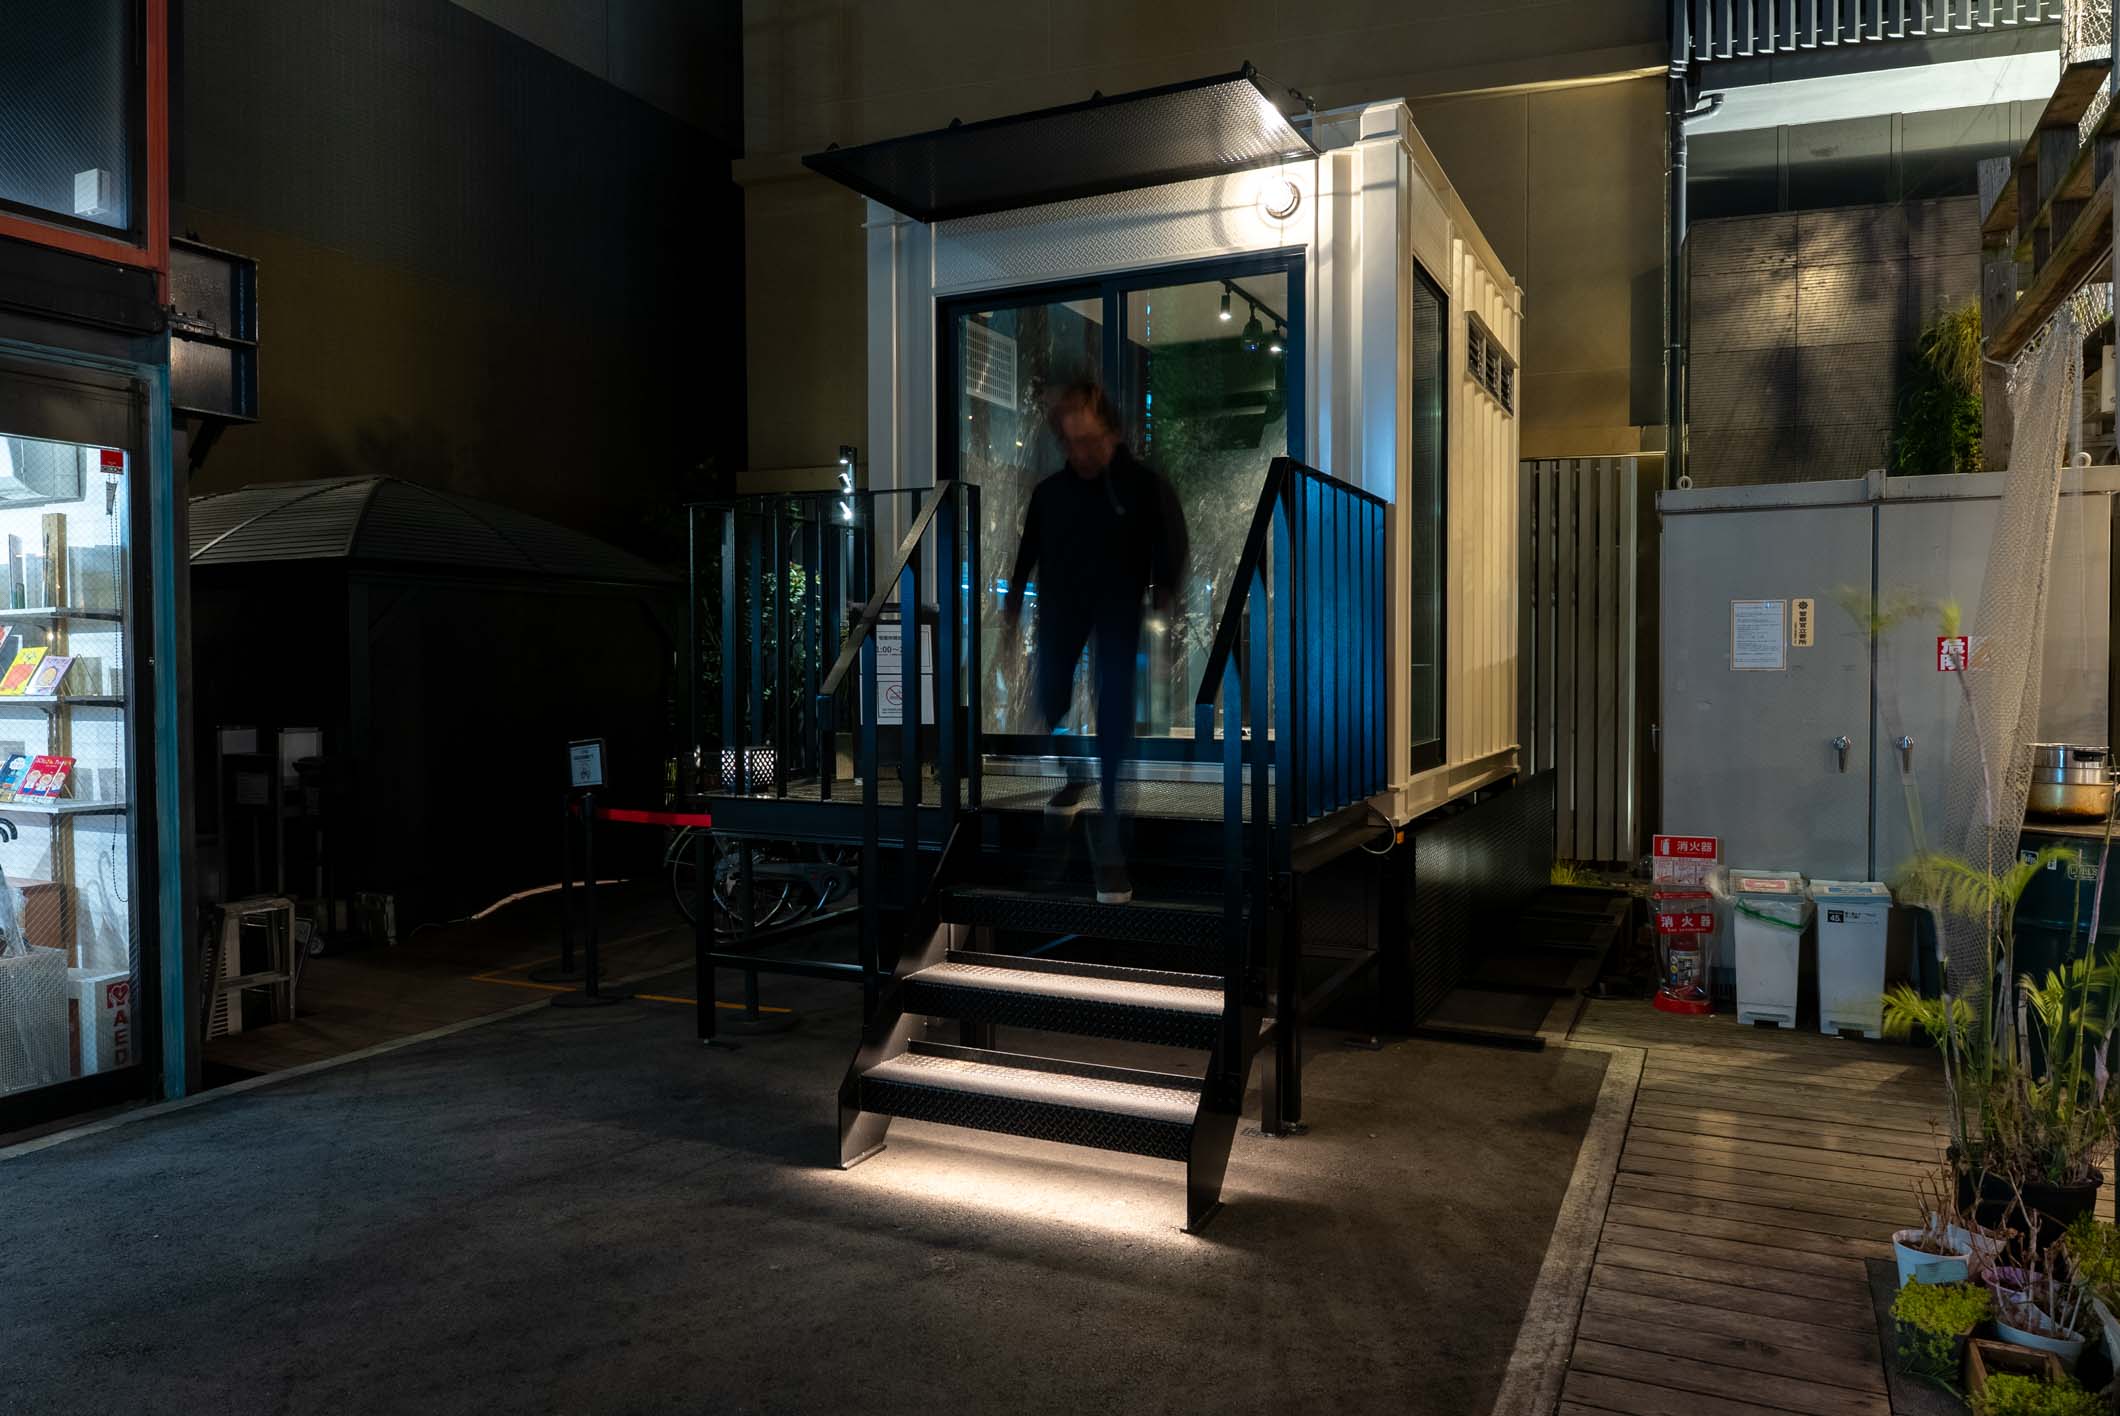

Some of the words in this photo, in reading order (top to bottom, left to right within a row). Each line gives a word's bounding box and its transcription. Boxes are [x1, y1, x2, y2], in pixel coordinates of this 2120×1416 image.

[1676, 840, 1713, 853] 消火器
[1661, 915, 1712, 928] 消火器
